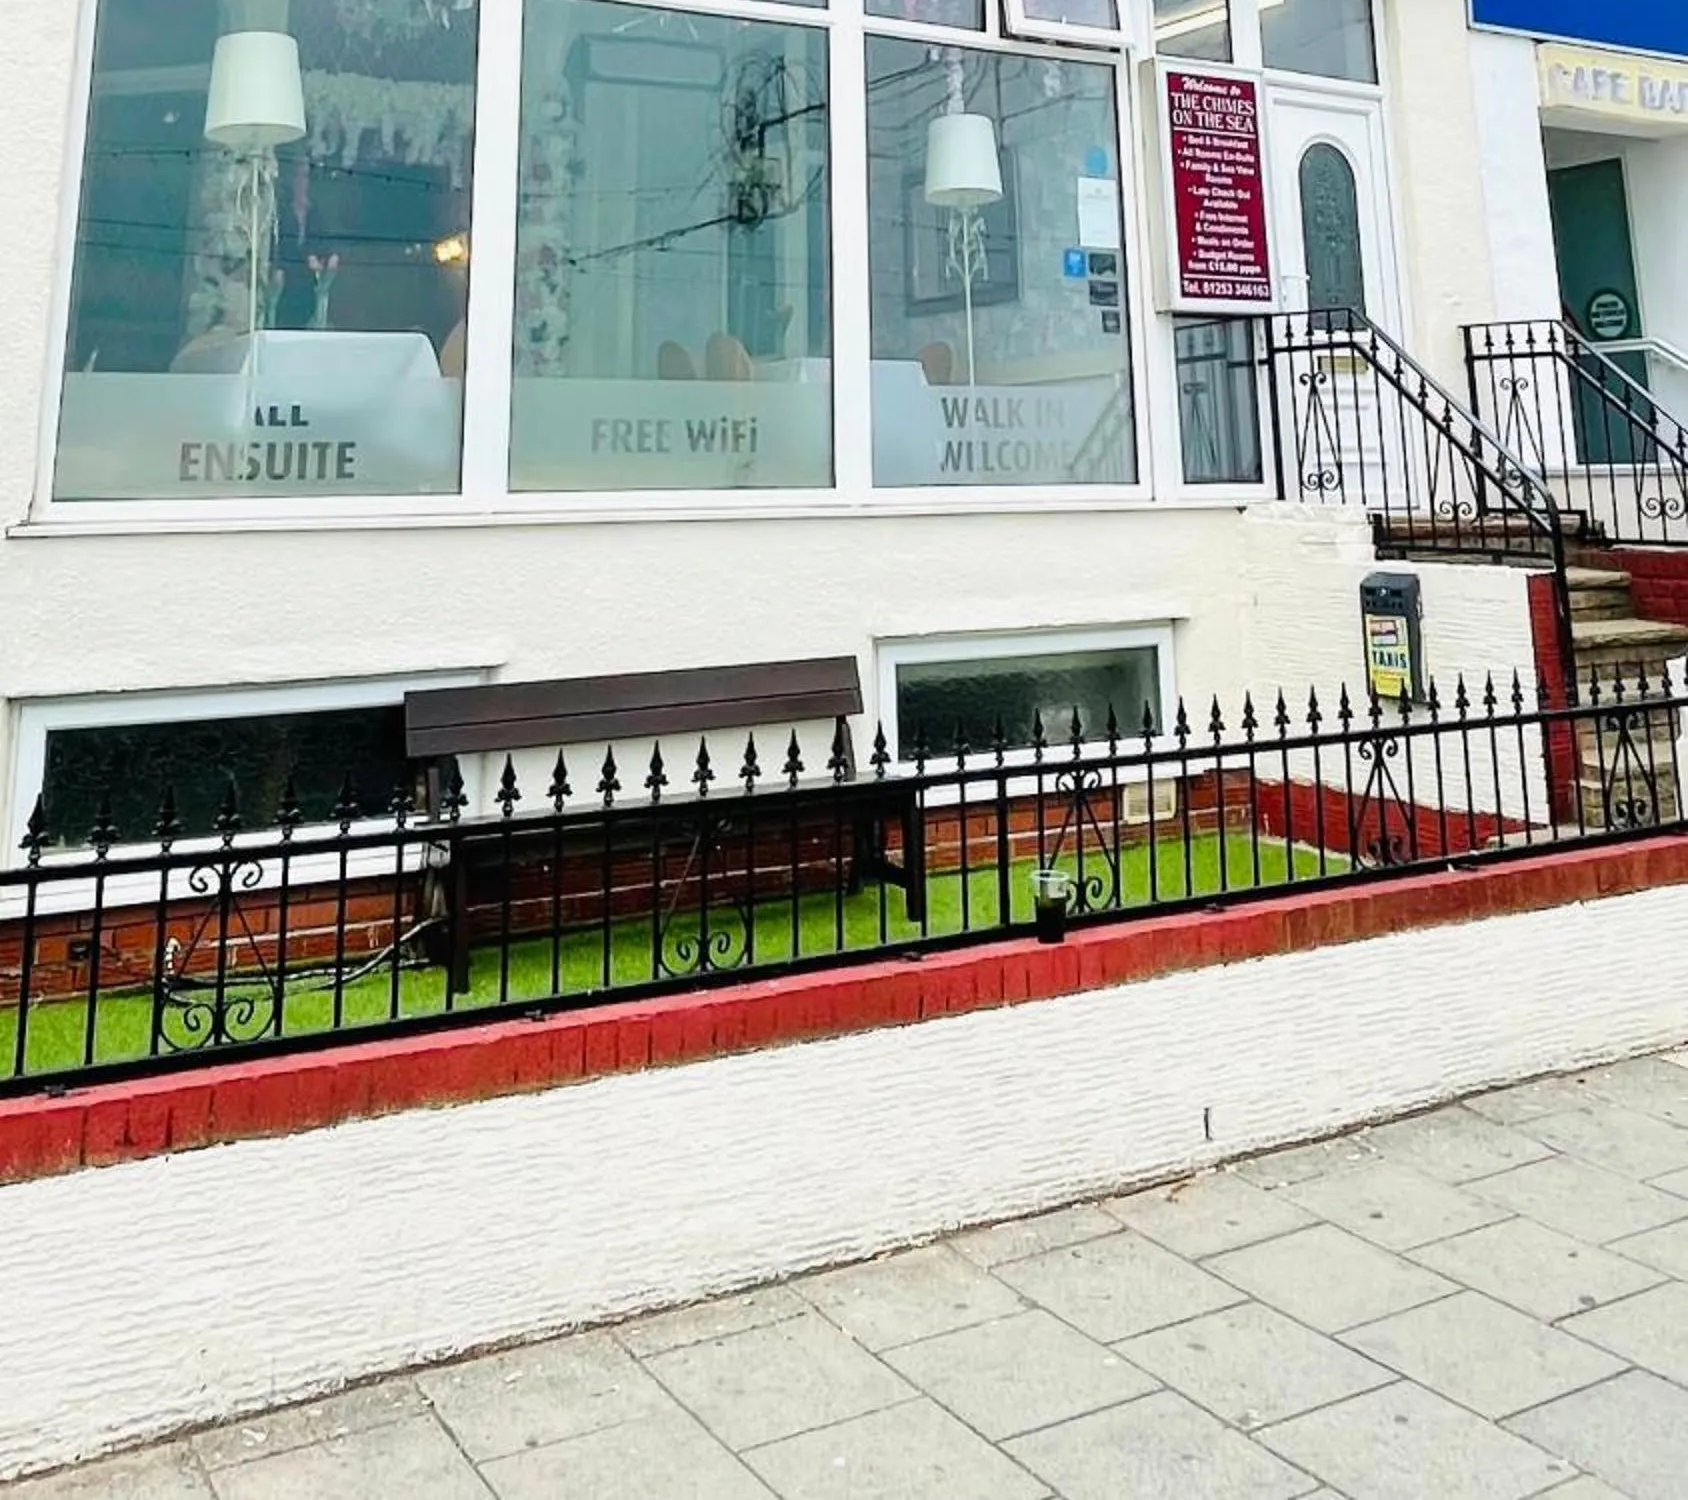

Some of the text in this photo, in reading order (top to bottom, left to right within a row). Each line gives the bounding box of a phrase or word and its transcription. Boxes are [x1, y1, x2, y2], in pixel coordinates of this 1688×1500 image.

[1181, 76, 1228, 95] Welcome
[1548, 62, 1633, 105] CAFE
[1170, 91, 1255, 117] THE CHIMES
[1173, 109, 1255, 133] ON THE SEA
[1203, 281, 1233, 295] 01253
[1234, 283, 1269, 297] 346163
[940, 396, 1065, 429] WALK IN
[590, 414, 758, 454] FREE WiFi
[179, 440, 357, 482] ENSUITE
